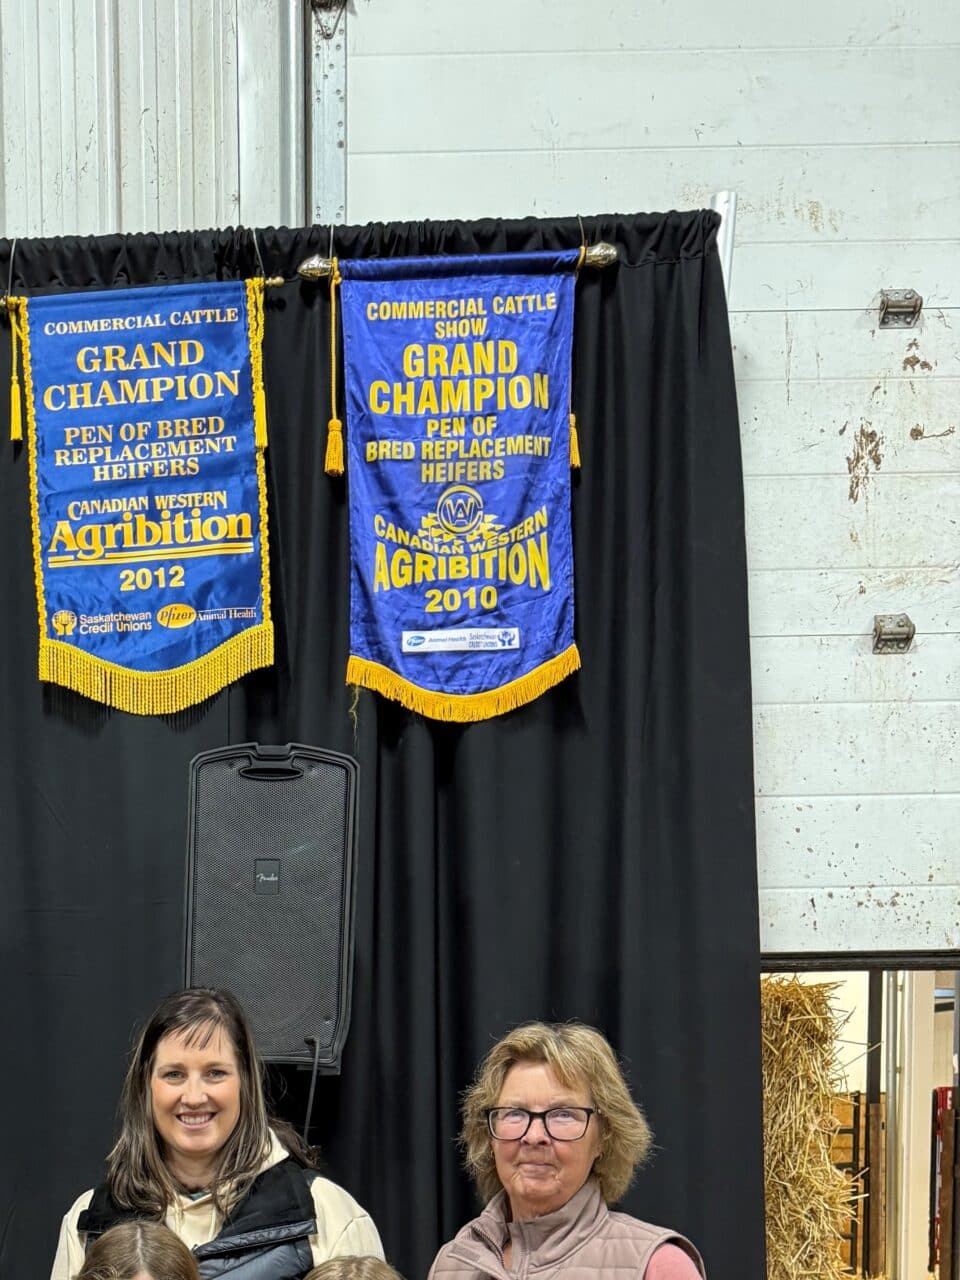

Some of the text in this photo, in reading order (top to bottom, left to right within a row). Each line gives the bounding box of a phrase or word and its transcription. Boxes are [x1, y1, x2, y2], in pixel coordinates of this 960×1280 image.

[366, 292, 557, 321] COMMERCIAL CATTLE
[44, 308, 238, 336] COMMERCIAL CATTLE
[435, 317, 487, 339] SHOW
[76, 339, 205, 373] GRAND
[403, 340, 518, 379] GRAND
[43, 370, 240, 411] CHAMPION
[369, 372, 549, 415] CHAMPION
[64, 416, 225, 446] PEN OF BRED
[426, 415, 497, 438] PEN OF
[54, 436, 237, 466] REPLACEMENT
[365, 435, 552, 463] BRED REPLACEMENT
[93, 457, 200, 482] HEIFERS
[421, 459, 505, 483] HEIFERS
[67, 491, 227, 521] CANADIAN WESTERN
[48, 508, 253, 561] Agribition
[373, 504, 549, 554] CANADIAN WESTERN
[373, 532, 551, 593] AGRIBITION
[119, 565, 185, 592] 2012
[424, 586, 498, 613] 2010
[79, 611, 151, 625] Saskatchewan
[79, 622, 152, 635] Credit Unions
